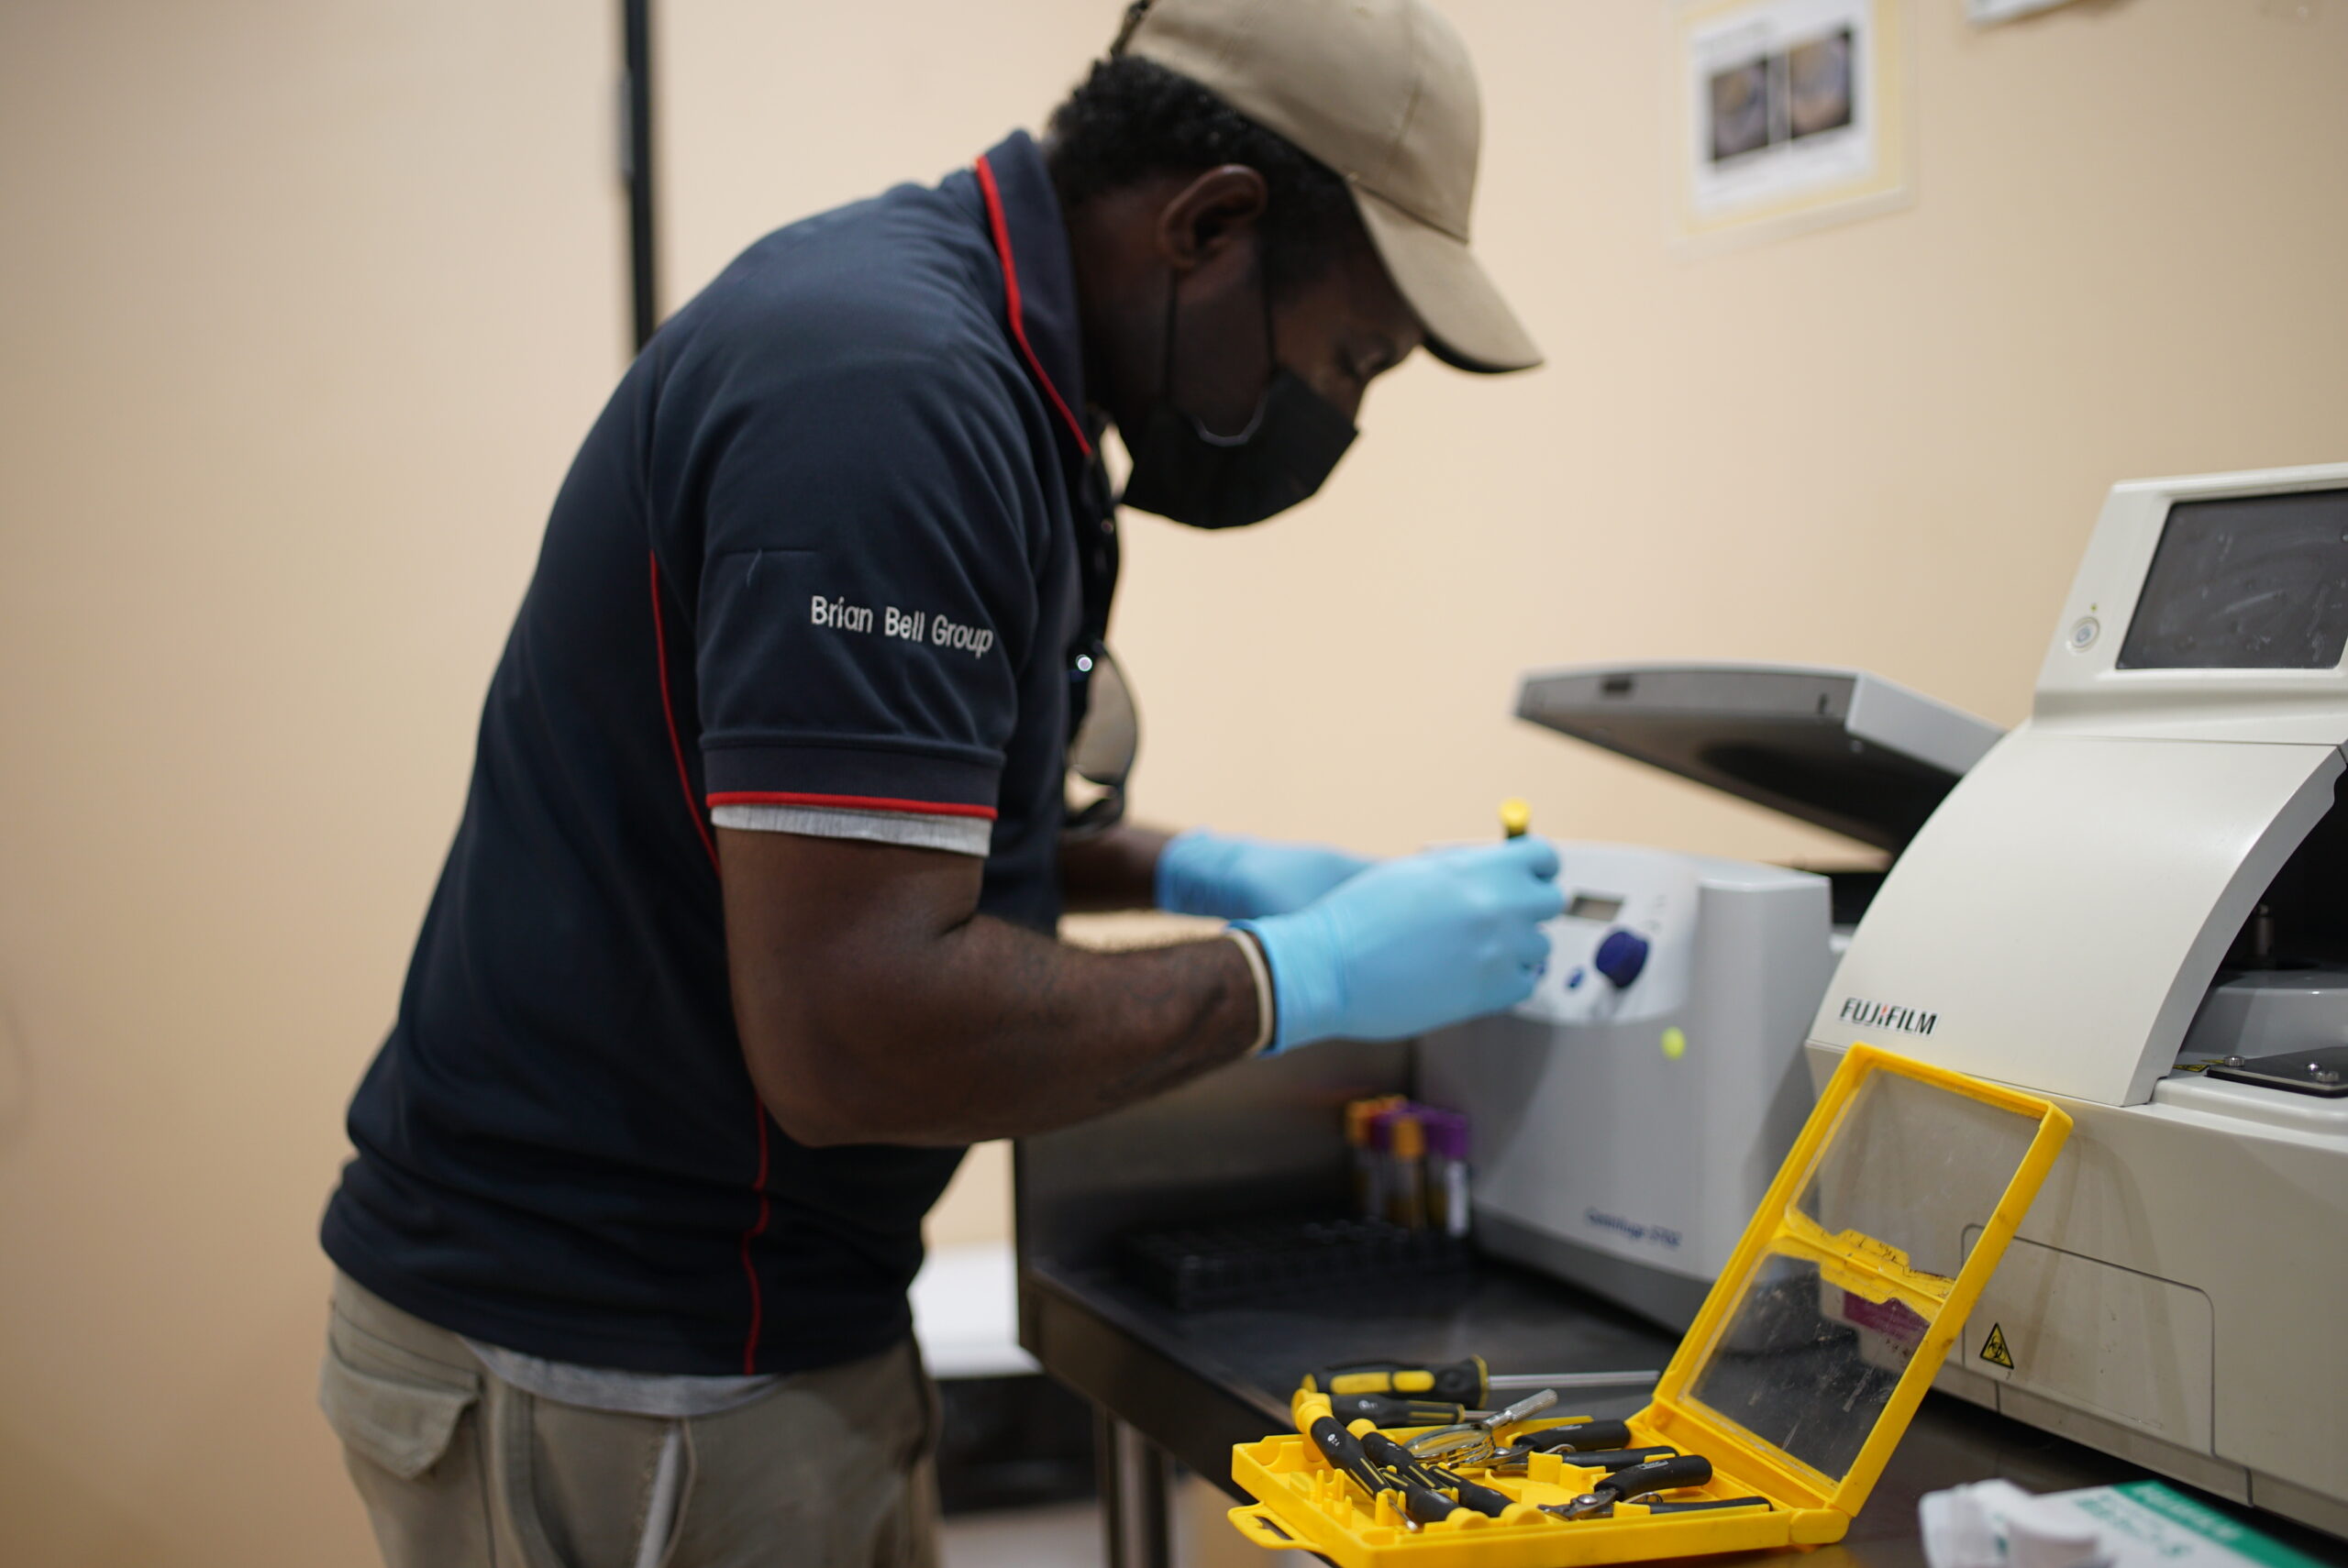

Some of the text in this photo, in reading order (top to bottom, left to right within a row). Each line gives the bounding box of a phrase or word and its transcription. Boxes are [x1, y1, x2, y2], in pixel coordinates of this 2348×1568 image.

[811, 595, 994, 659] Brian Bell Group
[1839, 997, 1938, 1035] FUJIFILM
